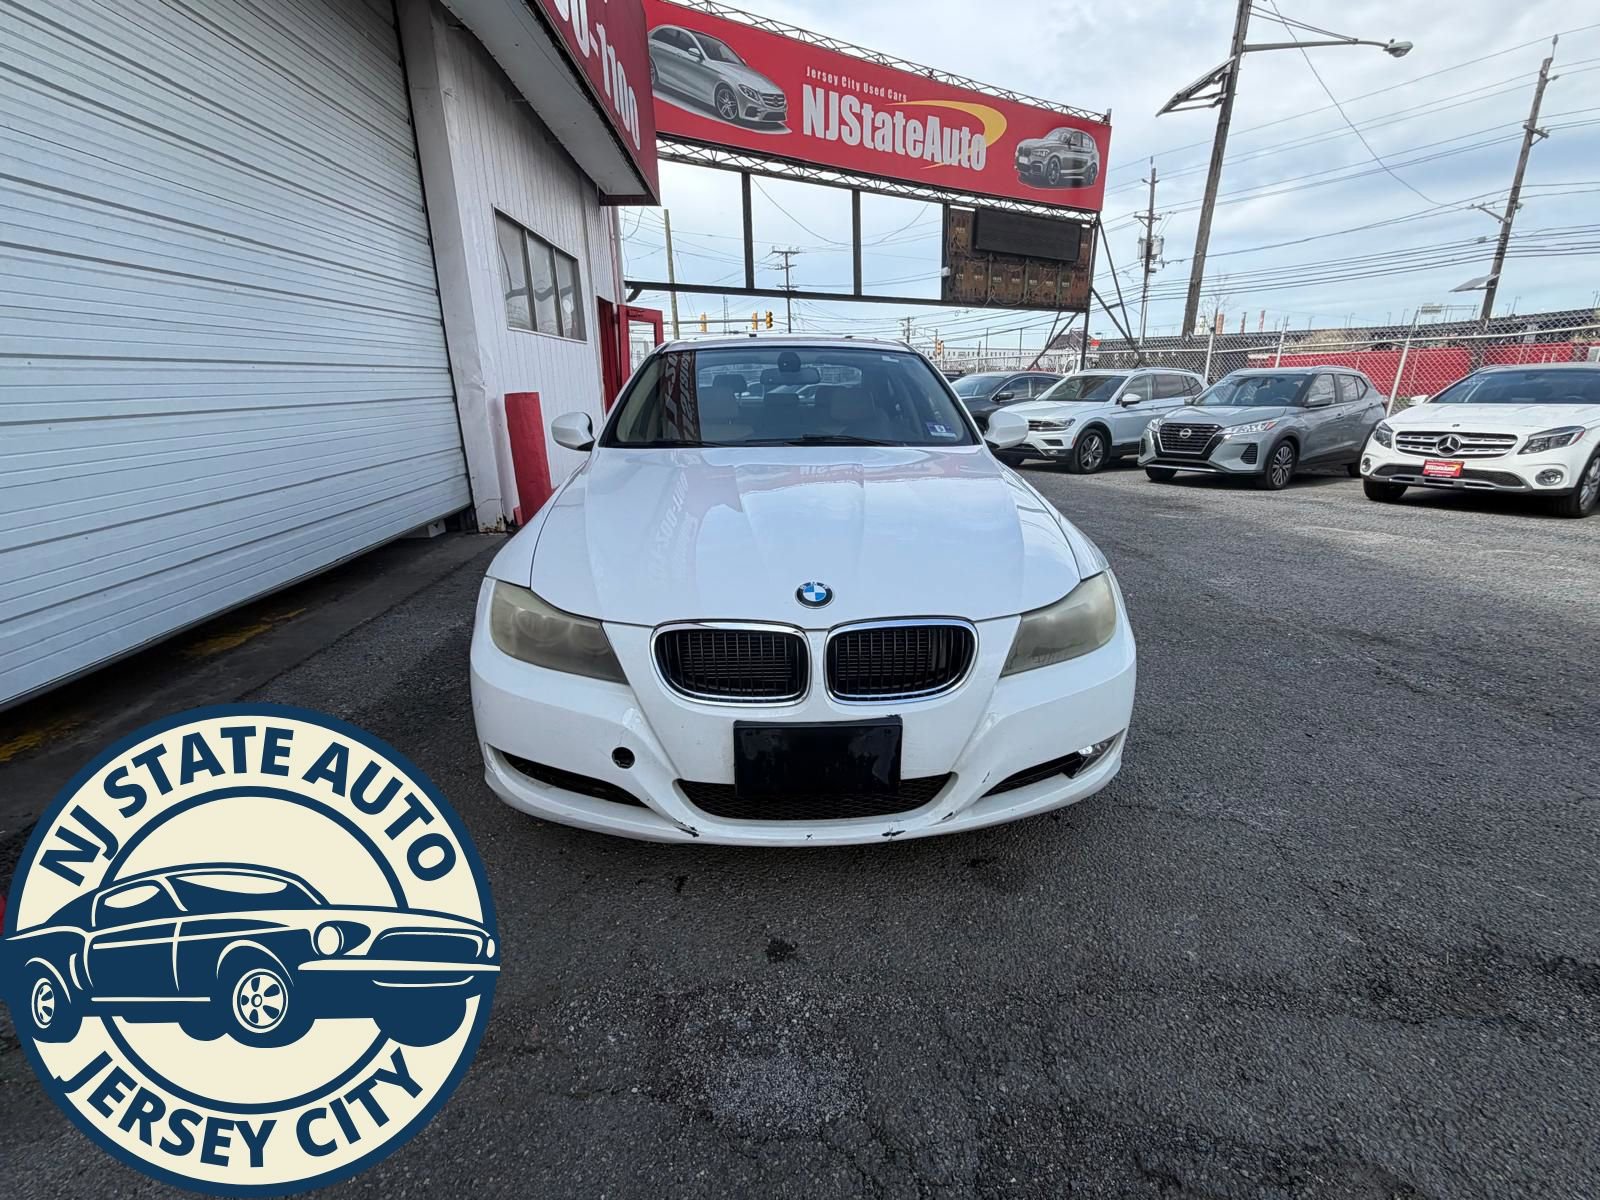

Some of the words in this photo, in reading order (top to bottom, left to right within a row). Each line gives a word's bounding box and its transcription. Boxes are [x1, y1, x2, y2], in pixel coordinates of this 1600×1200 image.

[553, 0, 640, 150] 0-1100
[806, 65, 838, 86] Jersey
[841, 75, 860, 92] City
[863, 82, 885, 97] Used
[887, 89, 908, 103] Cars
[802, 83, 988, 171] NJStateAuto
